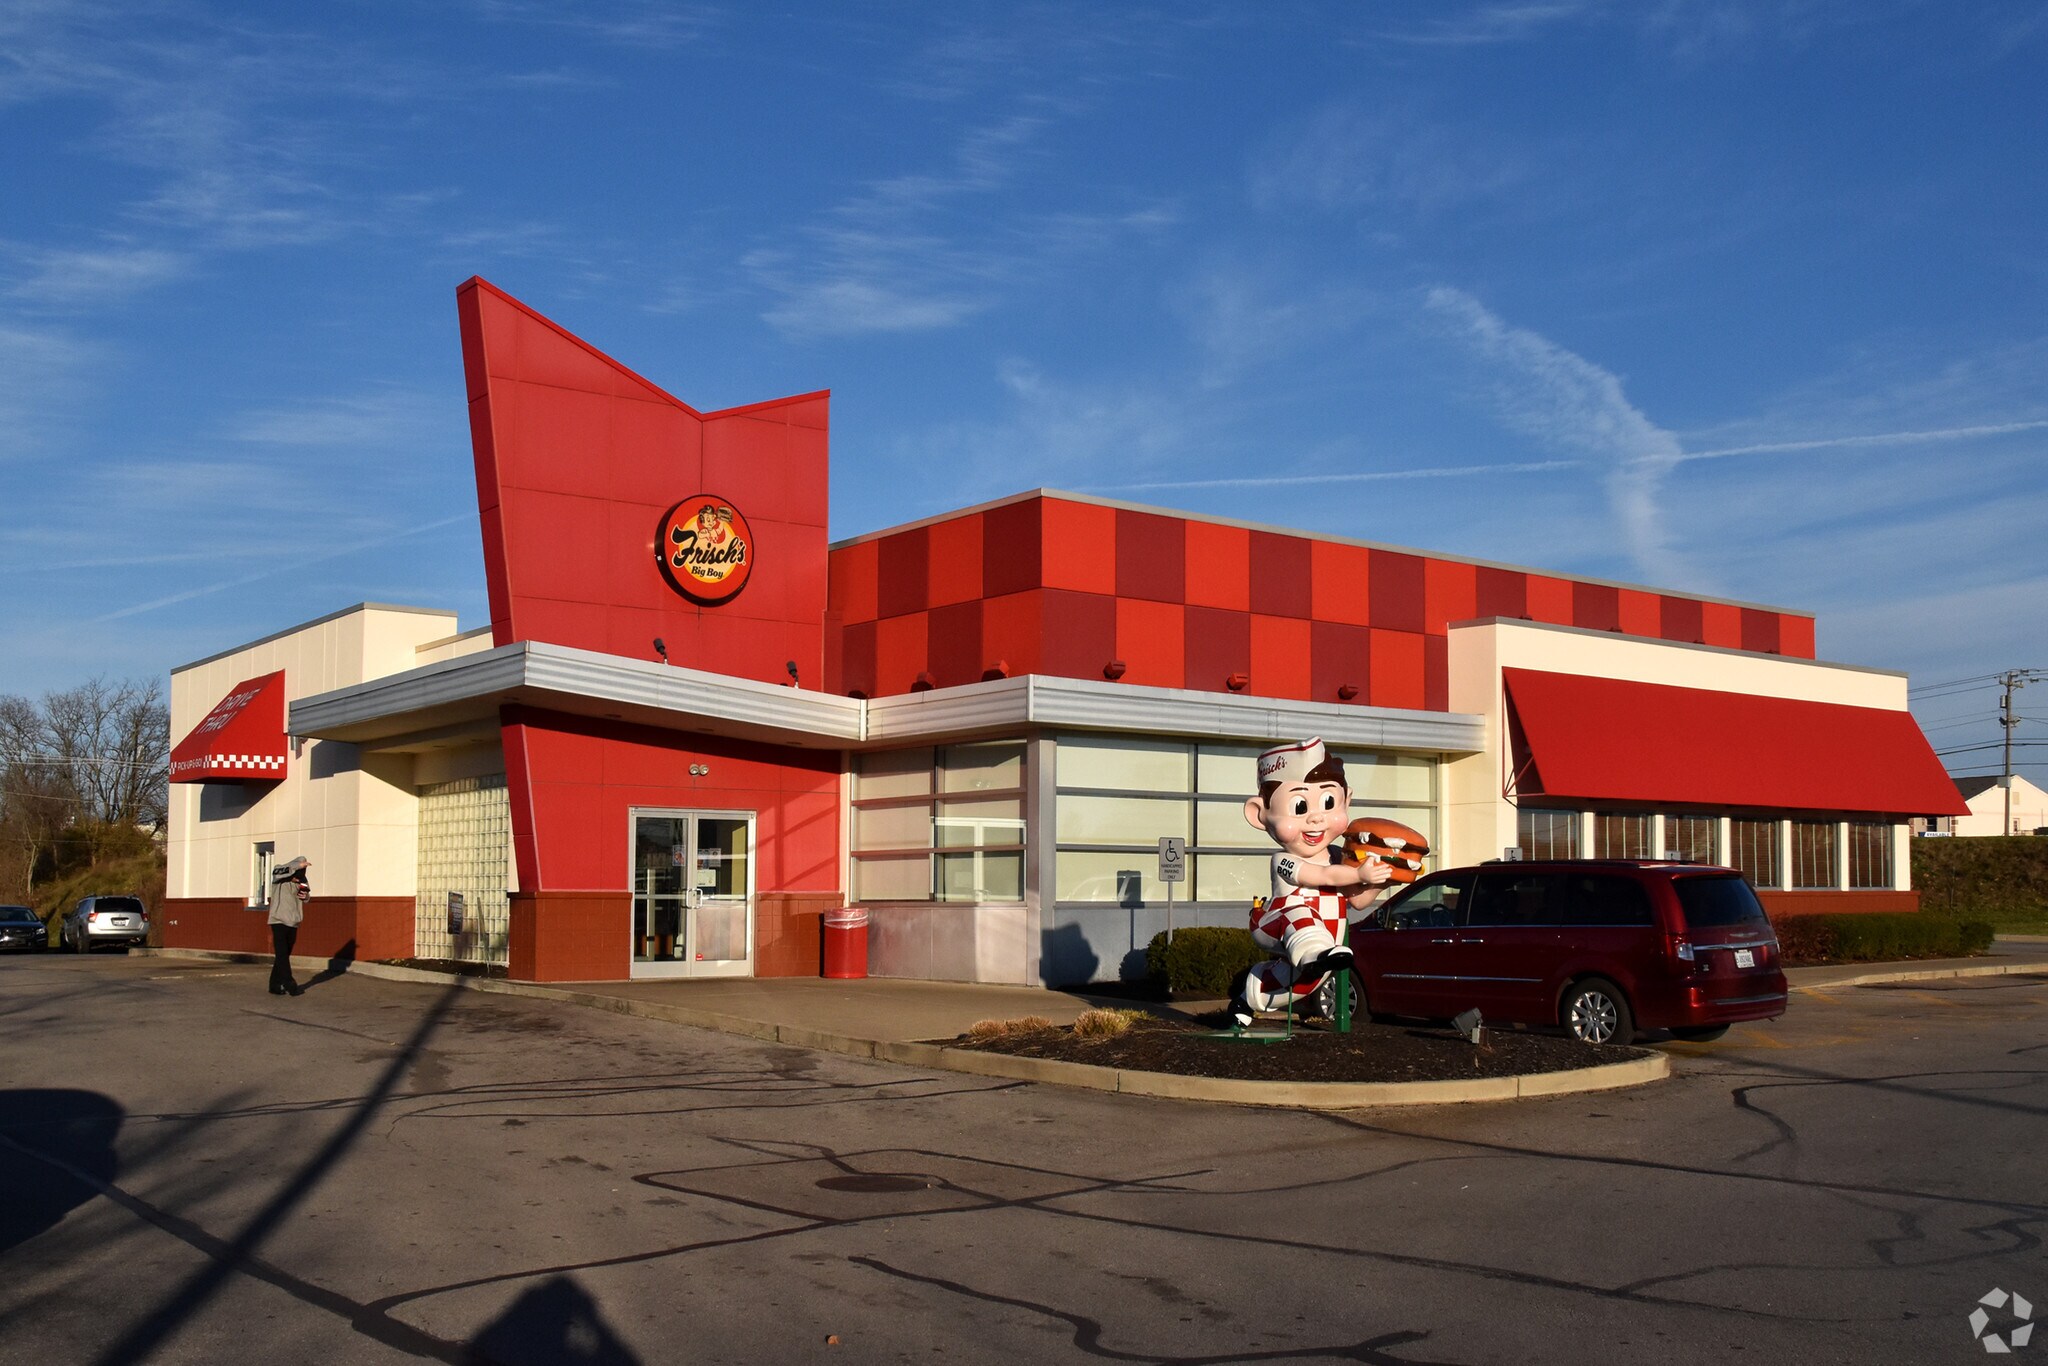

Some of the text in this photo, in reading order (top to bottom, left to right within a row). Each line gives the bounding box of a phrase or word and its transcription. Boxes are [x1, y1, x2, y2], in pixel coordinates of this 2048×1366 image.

[672, 526, 745, 566] Frisch's
[691, 566, 724, 579] Big Boy
[213, 688, 261, 713] DRIVE
[195, 711, 238, 735] THRU
[1277, 865, 1293, 878] BOY
[1280, 858, 1295, 869] BIG
